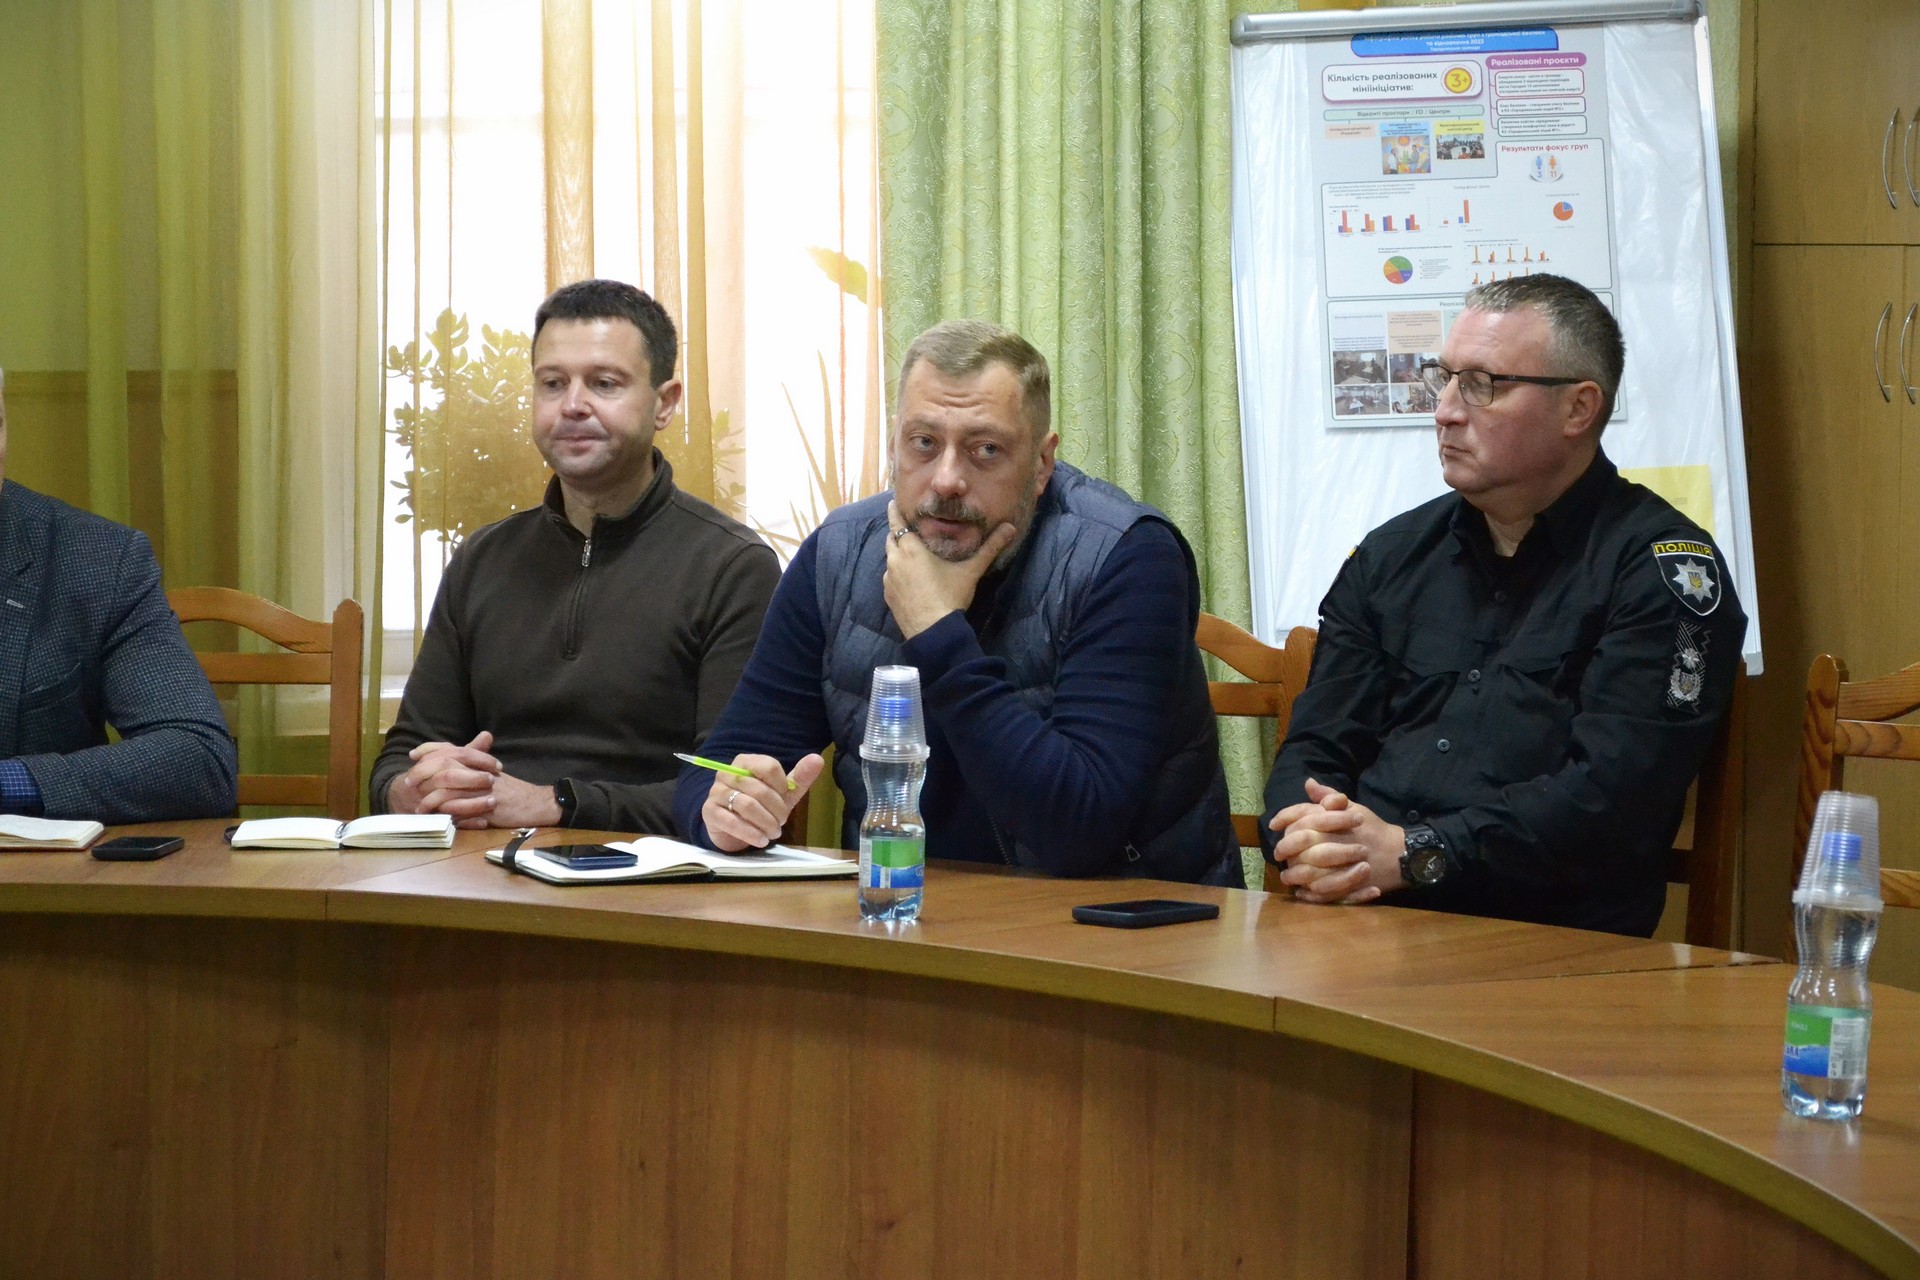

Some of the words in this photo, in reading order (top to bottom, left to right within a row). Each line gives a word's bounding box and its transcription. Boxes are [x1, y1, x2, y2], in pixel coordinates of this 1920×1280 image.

[1491, 56, 1542, 67] Реалізовані
[1543, 56, 1580, 66] проєкти
[1327, 73, 1370, 82] Кількість
[1371, 72, 1438, 83] реалізованих
[1450, 73, 1468, 88] 3+
[1352, 83, 1414, 93] мініініціатив:
[1501, 145, 1544, 153] Результати
[1545, 144, 1569, 152] фокус
[1570, 143, 1589, 151] груп
[1654, 542, 1712, 556] ПОЛІЦІЯ
